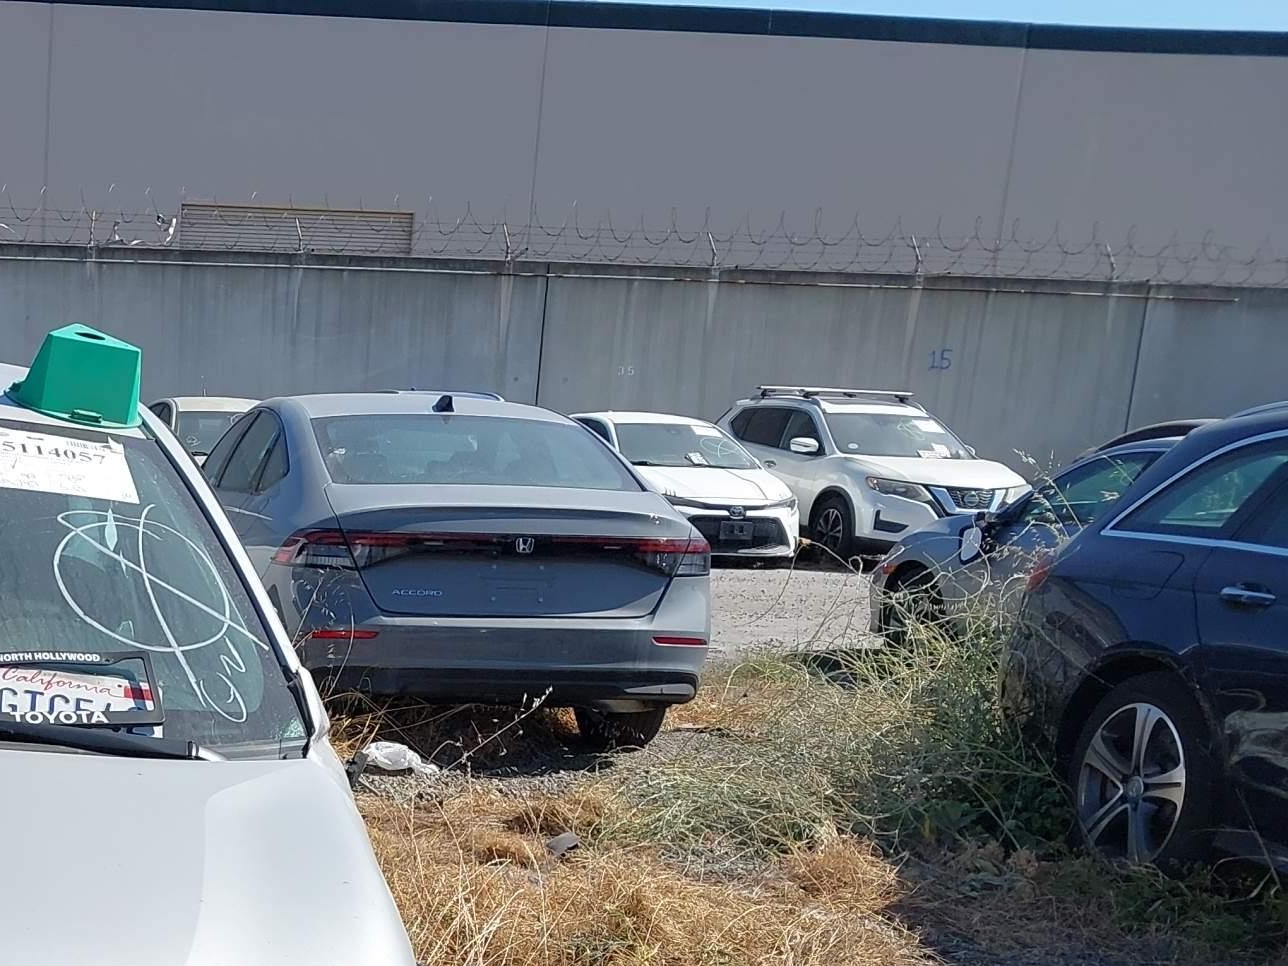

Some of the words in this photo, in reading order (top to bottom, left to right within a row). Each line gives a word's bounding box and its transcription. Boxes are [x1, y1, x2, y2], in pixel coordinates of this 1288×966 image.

[928, 348, 953, 371] 15
[392, 589, 443, 597] ACCORD
[33, 652, 101, 663] HOLLYWOOD
[1, 666, 119, 698] California
[9, 710, 109, 725] TOYOTA
